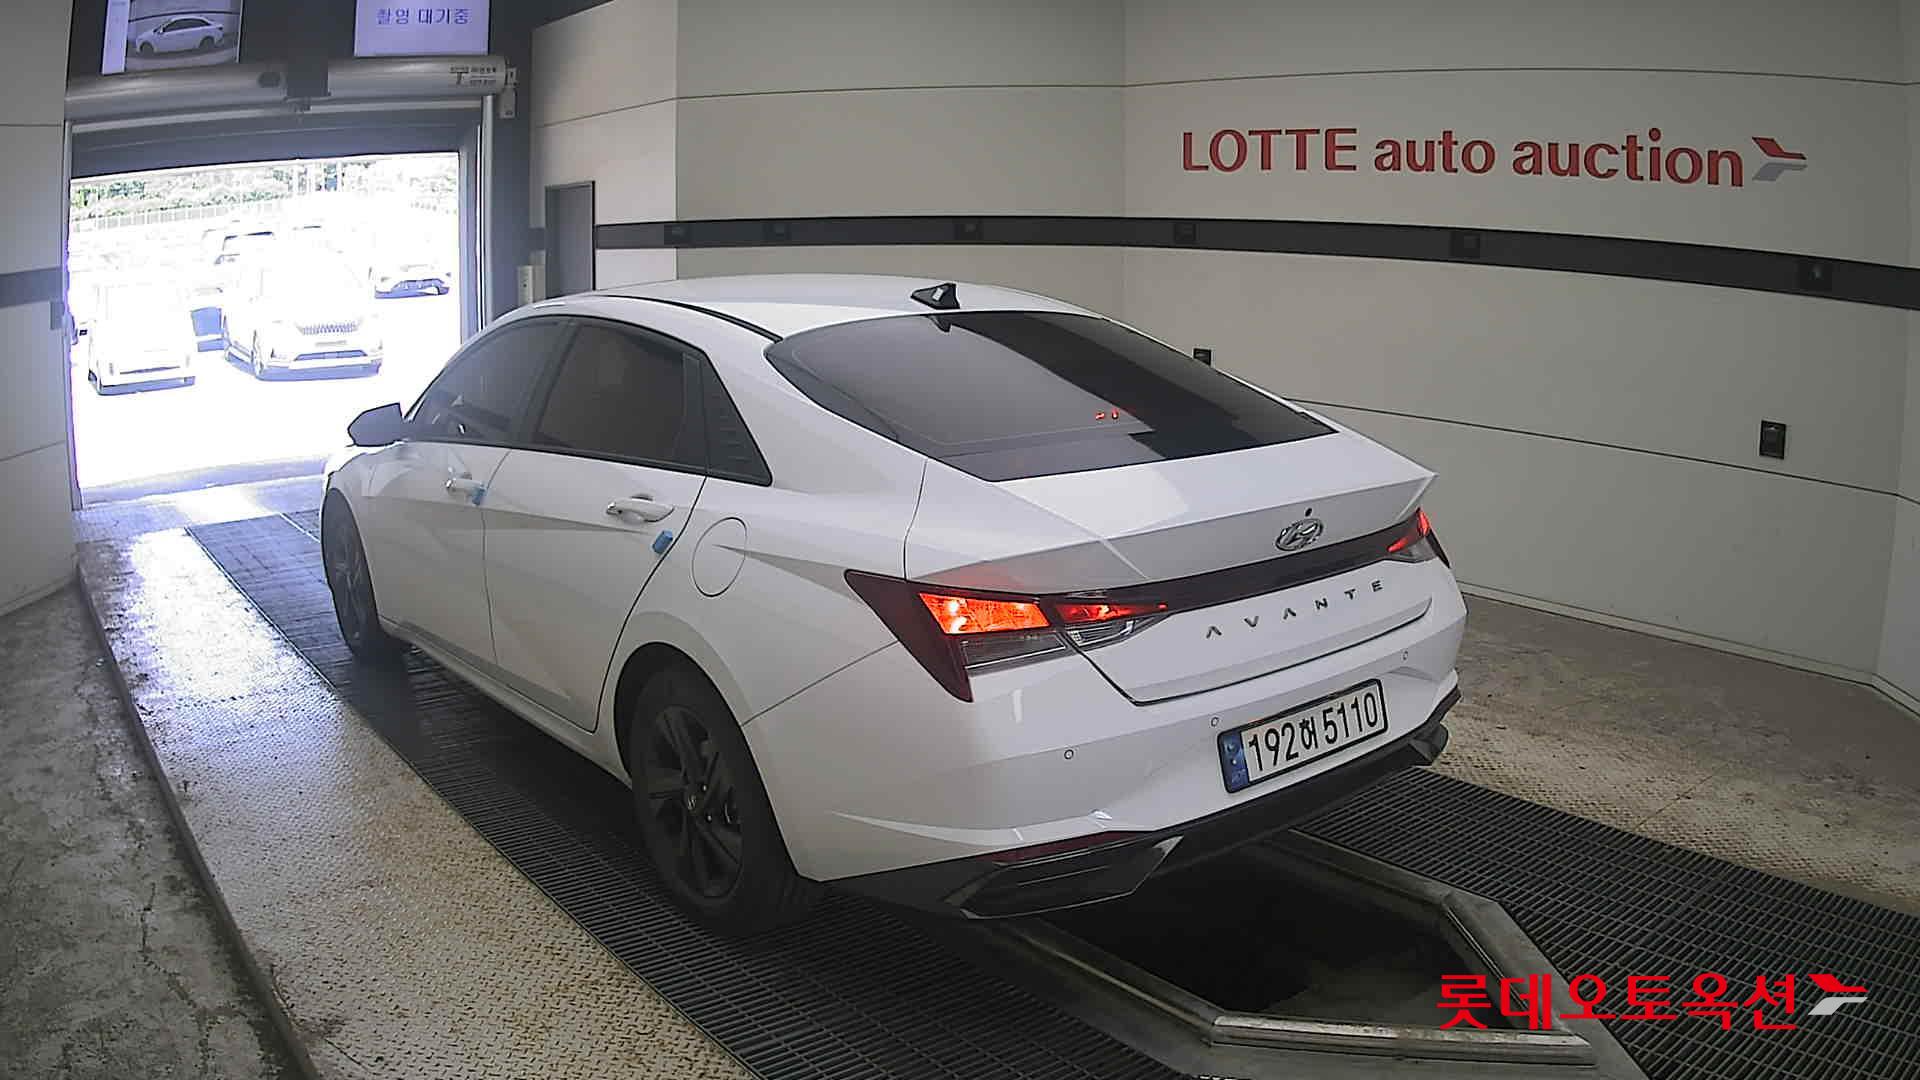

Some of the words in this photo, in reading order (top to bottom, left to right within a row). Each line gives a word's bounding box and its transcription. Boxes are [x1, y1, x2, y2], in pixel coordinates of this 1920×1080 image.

[418, 7, 469, 25] 대기중
[1182, 127, 1358, 172] LOTTE
[1373, 129, 1497, 175] auto
[1511, 127, 1744, 188] auction
[1205, 579, 1384, 639] AVANTE
